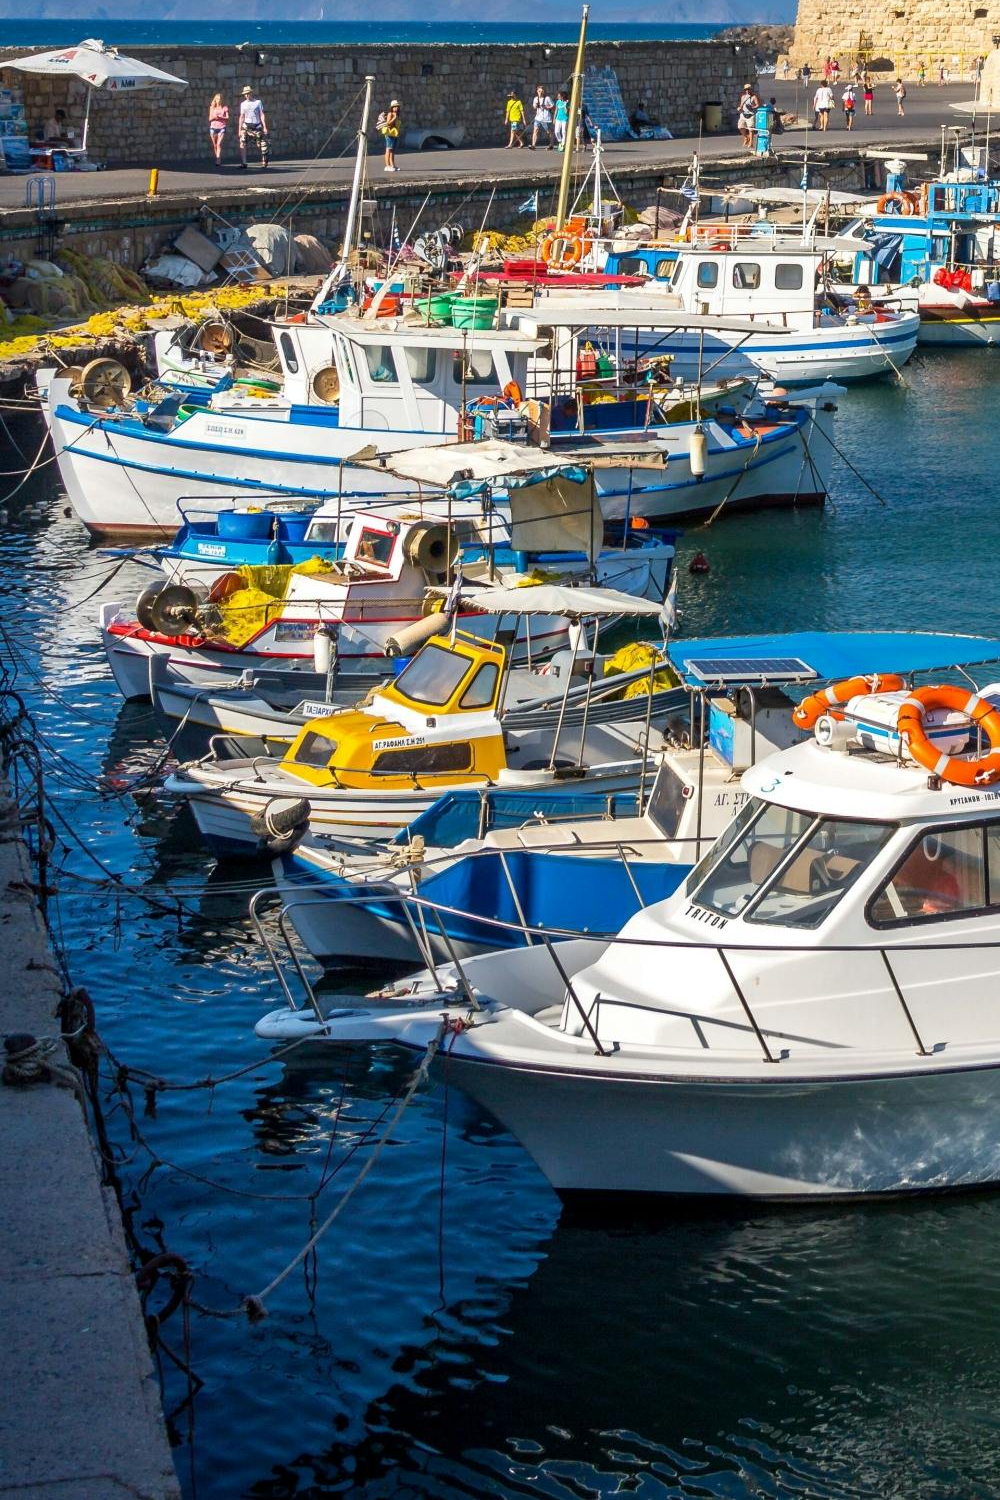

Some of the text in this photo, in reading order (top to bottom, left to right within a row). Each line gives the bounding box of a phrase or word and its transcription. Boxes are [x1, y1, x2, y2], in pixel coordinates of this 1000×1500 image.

[416, 737, 425, 745] 251
[714, 793, 729, 806] ΑΓ.
[685, 905, 729, 930] TRITON
